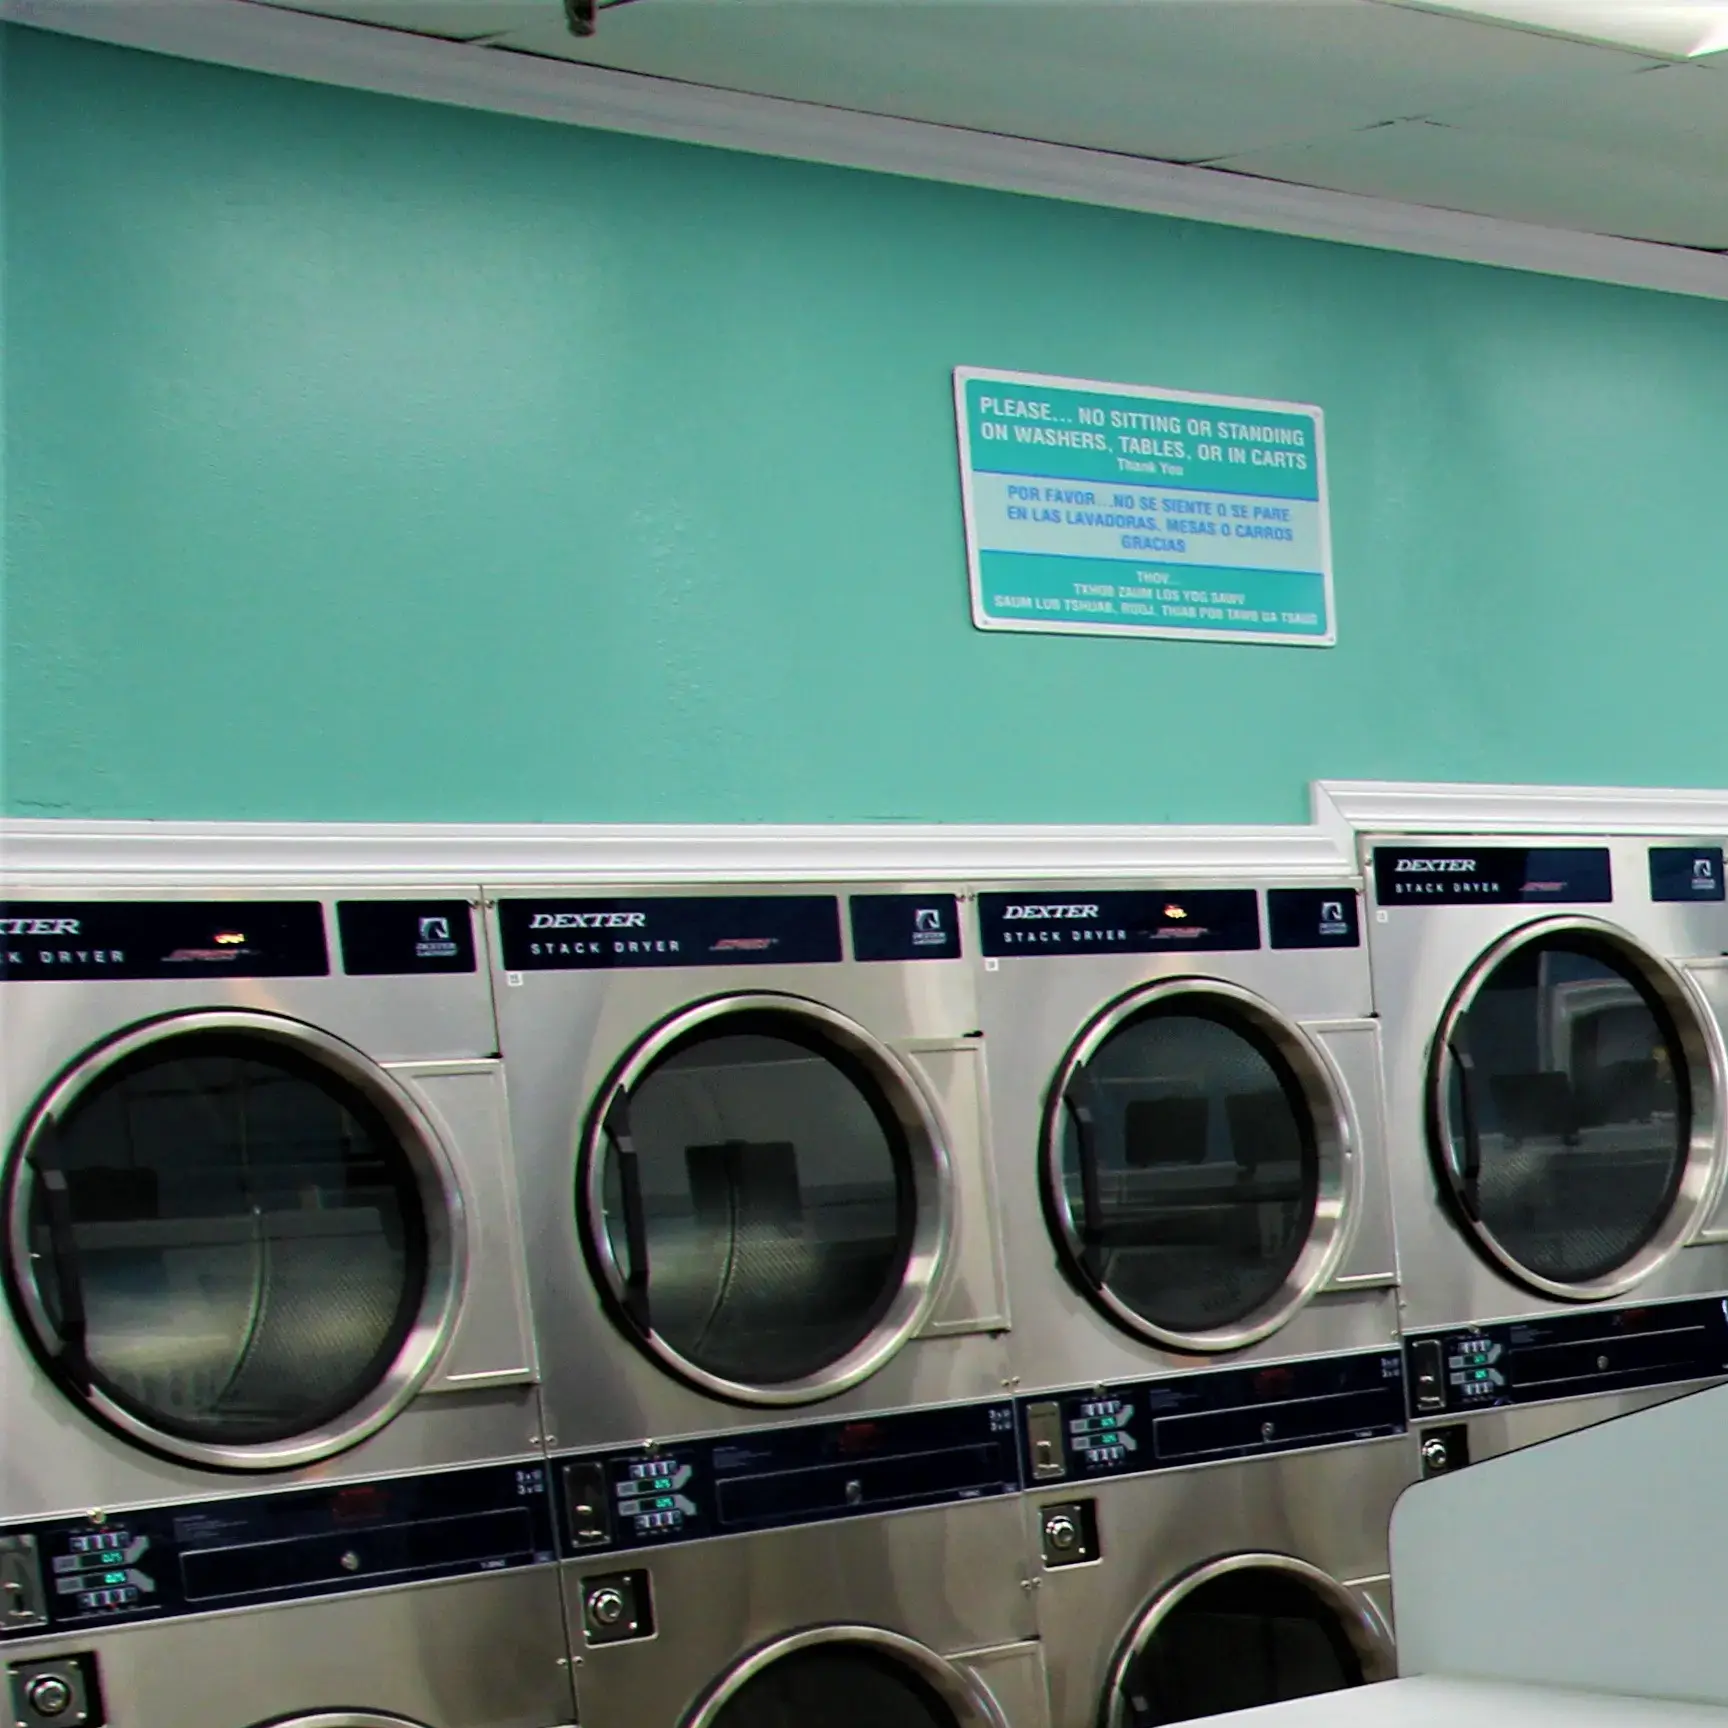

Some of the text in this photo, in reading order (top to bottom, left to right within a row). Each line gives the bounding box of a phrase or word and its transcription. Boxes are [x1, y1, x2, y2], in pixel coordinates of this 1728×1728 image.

[980, 397, 1305, 446] PLEASE... NO SITTING OR STANDING
[981, 422, 1008, 440] ON
[1198, 443, 1221, 462] OR
[1228, 447, 1245, 464] IN
[1251, 450, 1306, 469] CARTS
[1117, 457, 1183, 476] Thank You
[1007, 485, 1039, 501] POR
[1138, 494, 1158, 510] SE
[1162, 497, 1211, 516] SIENTE
[1231, 503, 1248, 518] SE
[1253, 505, 1290, 521] PARE
[1007, 505, 1027, 520] EN
[1032, 507, 1060, 524] LAS
[1166, 517, 1215, 535] MESAS
[1234, 523, 1294, 541] CARROS
[1120, 533, 1186, 552] GRACIAS
[1394, 858, 1477, 872] DEXTER
[1395, 881, 1500, 894] STACK DRYER
[529, 912, 647, 928] DEXTER
[1002, 904, 1100, 920] DEXTER
[1002, 929, 1128, 944] STACK DRYER
[530, 940, 681, 955] STACK DRYER
[38, 950, 126, 964] DRYER
